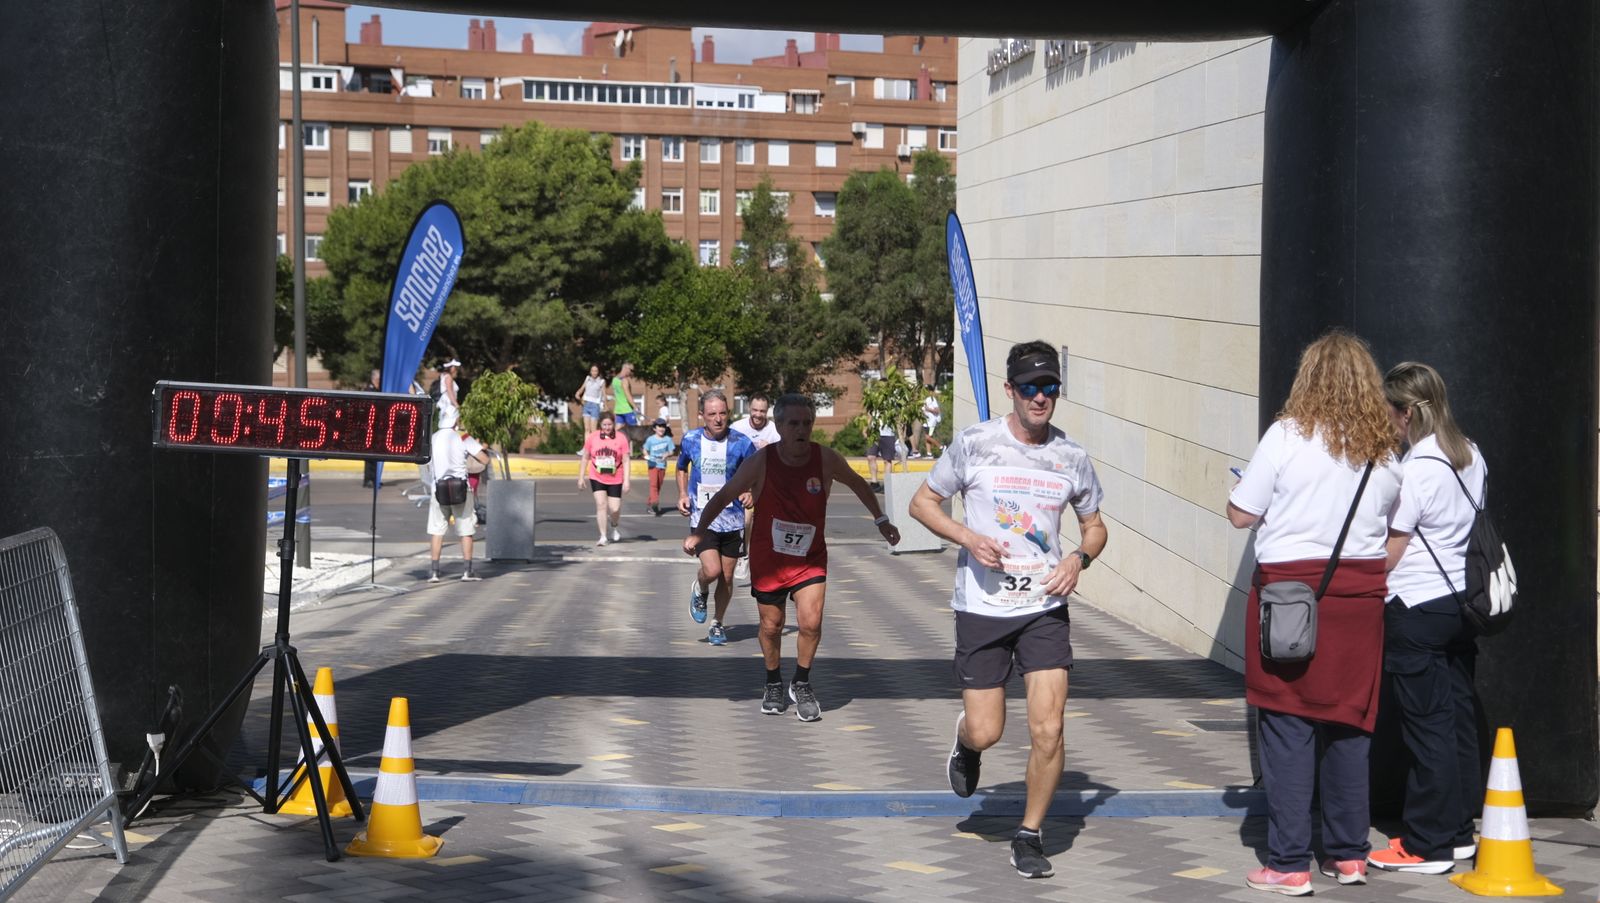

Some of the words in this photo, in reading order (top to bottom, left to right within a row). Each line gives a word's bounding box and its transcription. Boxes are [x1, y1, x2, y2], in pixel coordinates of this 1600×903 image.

[168, 391, 417, 453] 00:45:10
[784, 533, 804, 545] 57
[1004, 575, 1032, 592] 32
